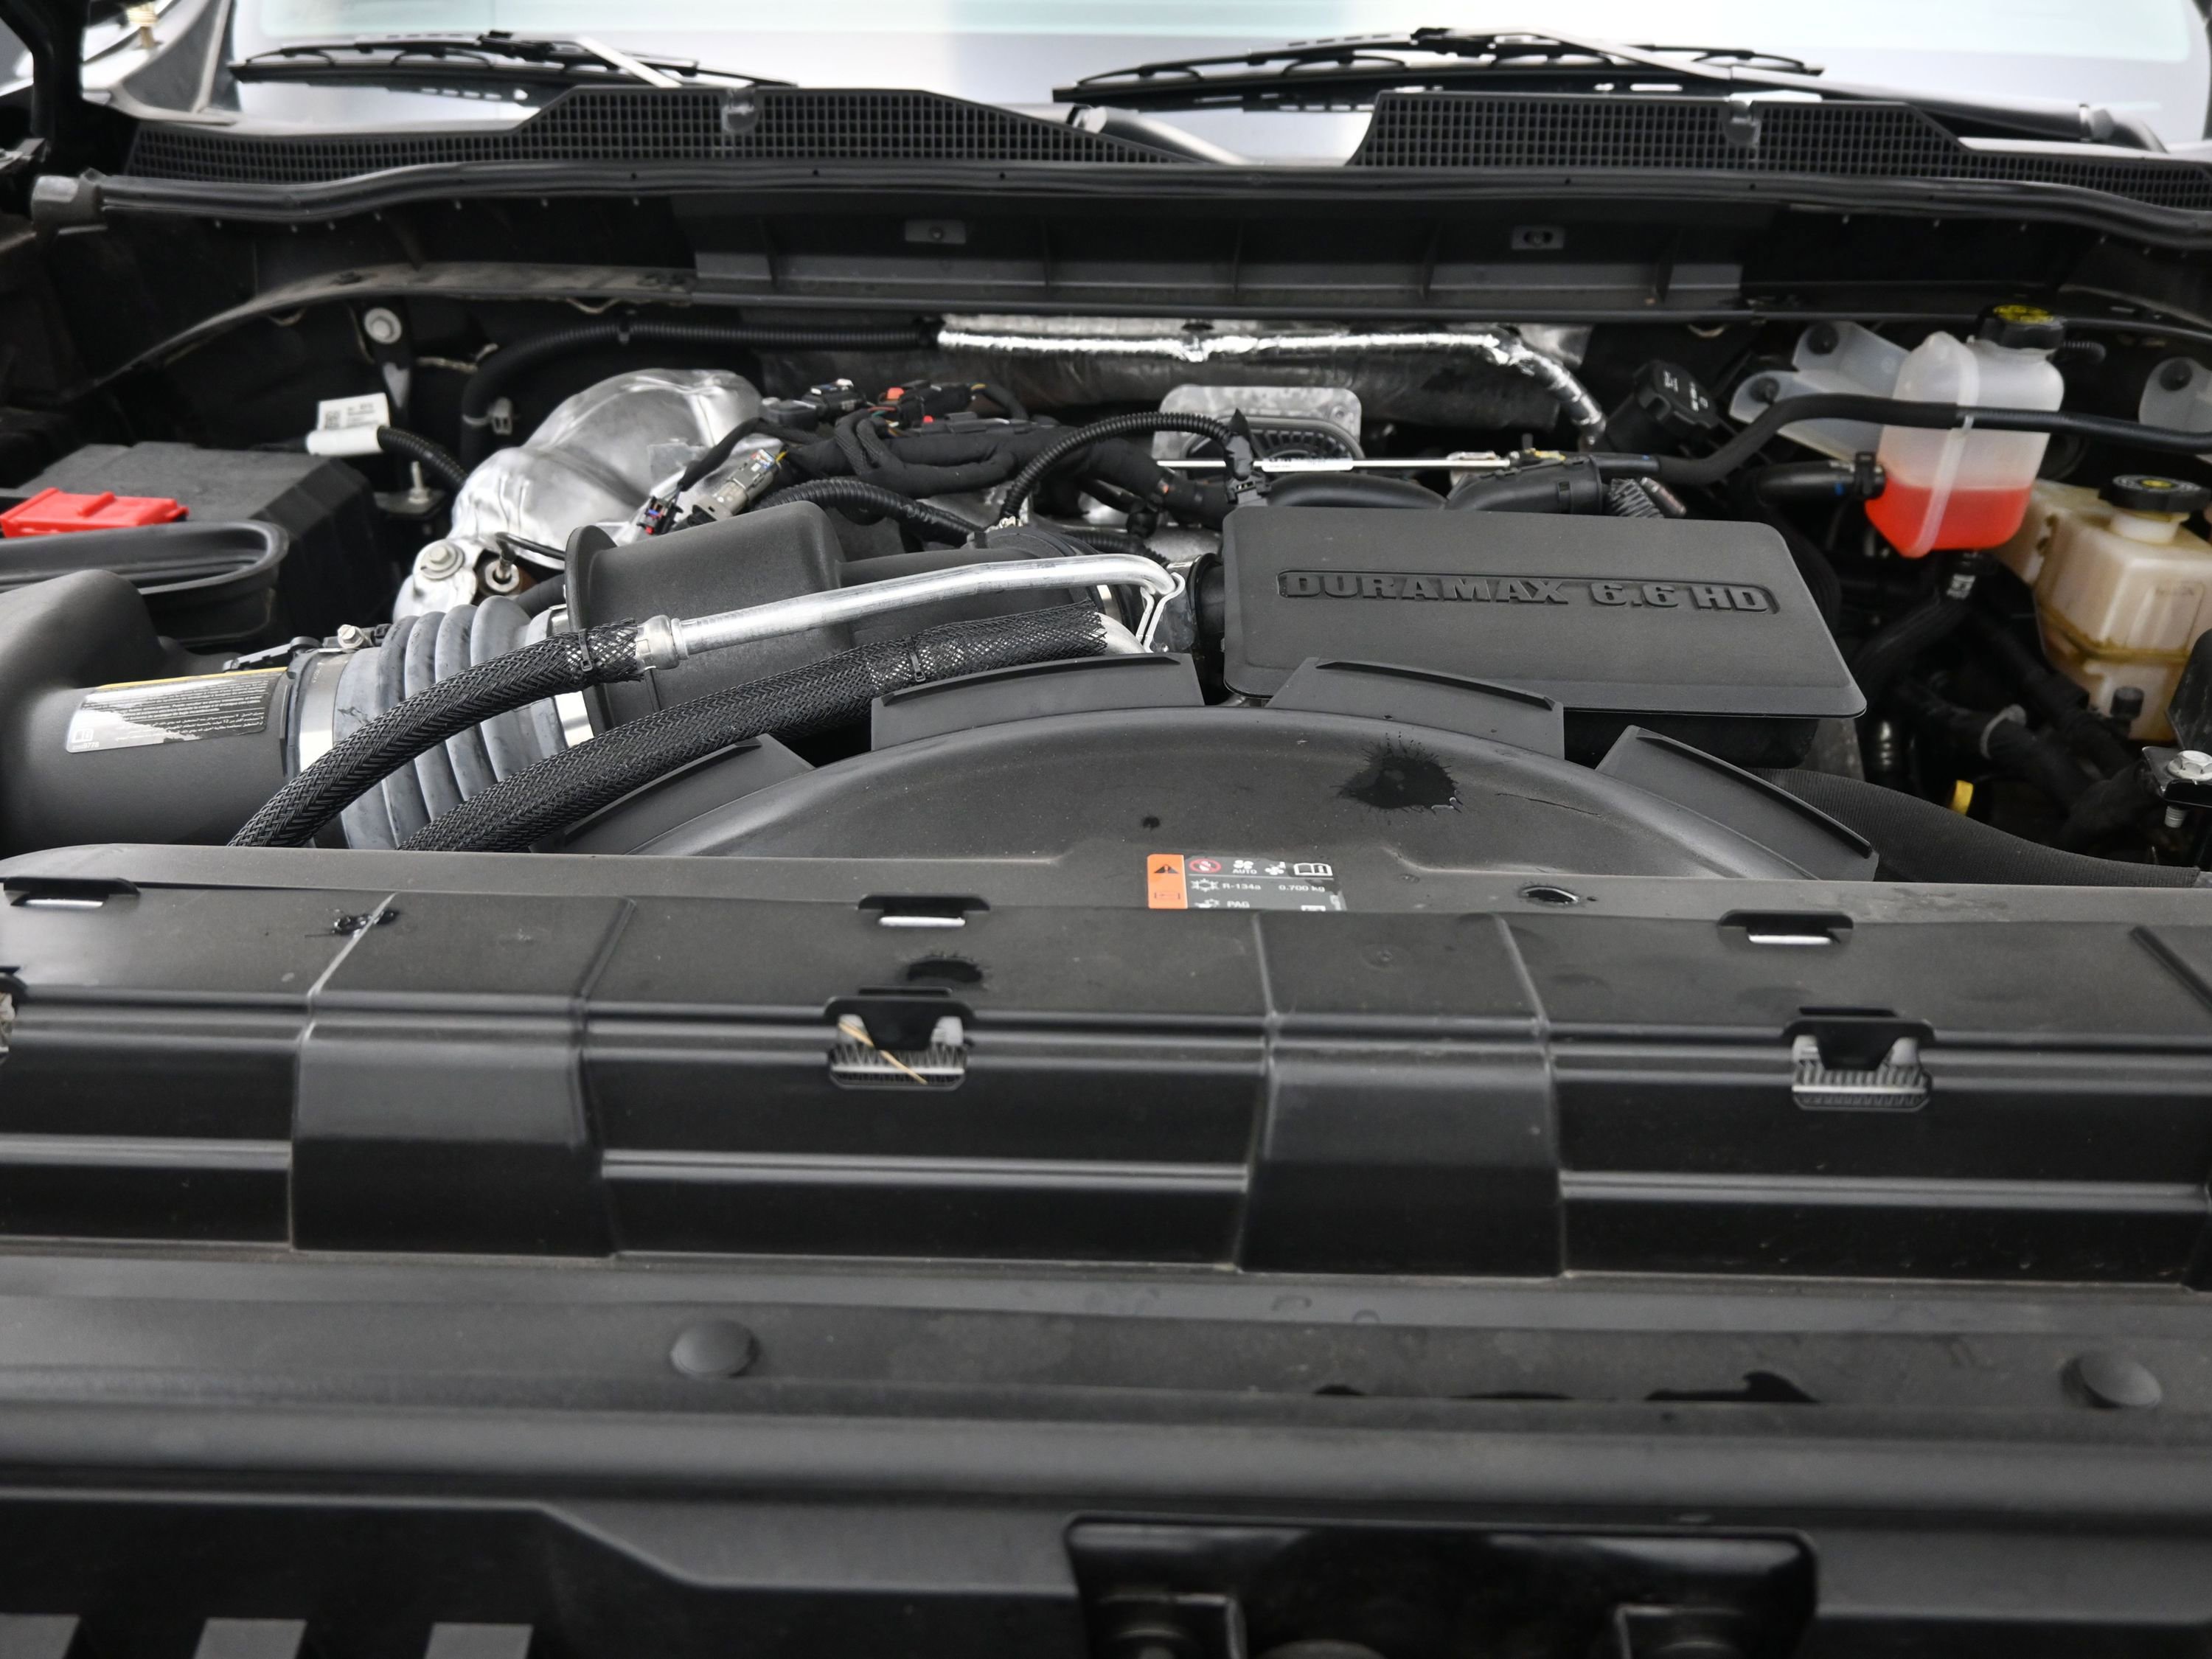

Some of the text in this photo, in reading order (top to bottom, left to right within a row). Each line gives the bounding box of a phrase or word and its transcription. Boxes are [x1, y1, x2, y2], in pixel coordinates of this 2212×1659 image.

[1286, 572, 1770, 613] DURAMAX 6.6 HD
[1227, 900, 1250, 908] PAG
